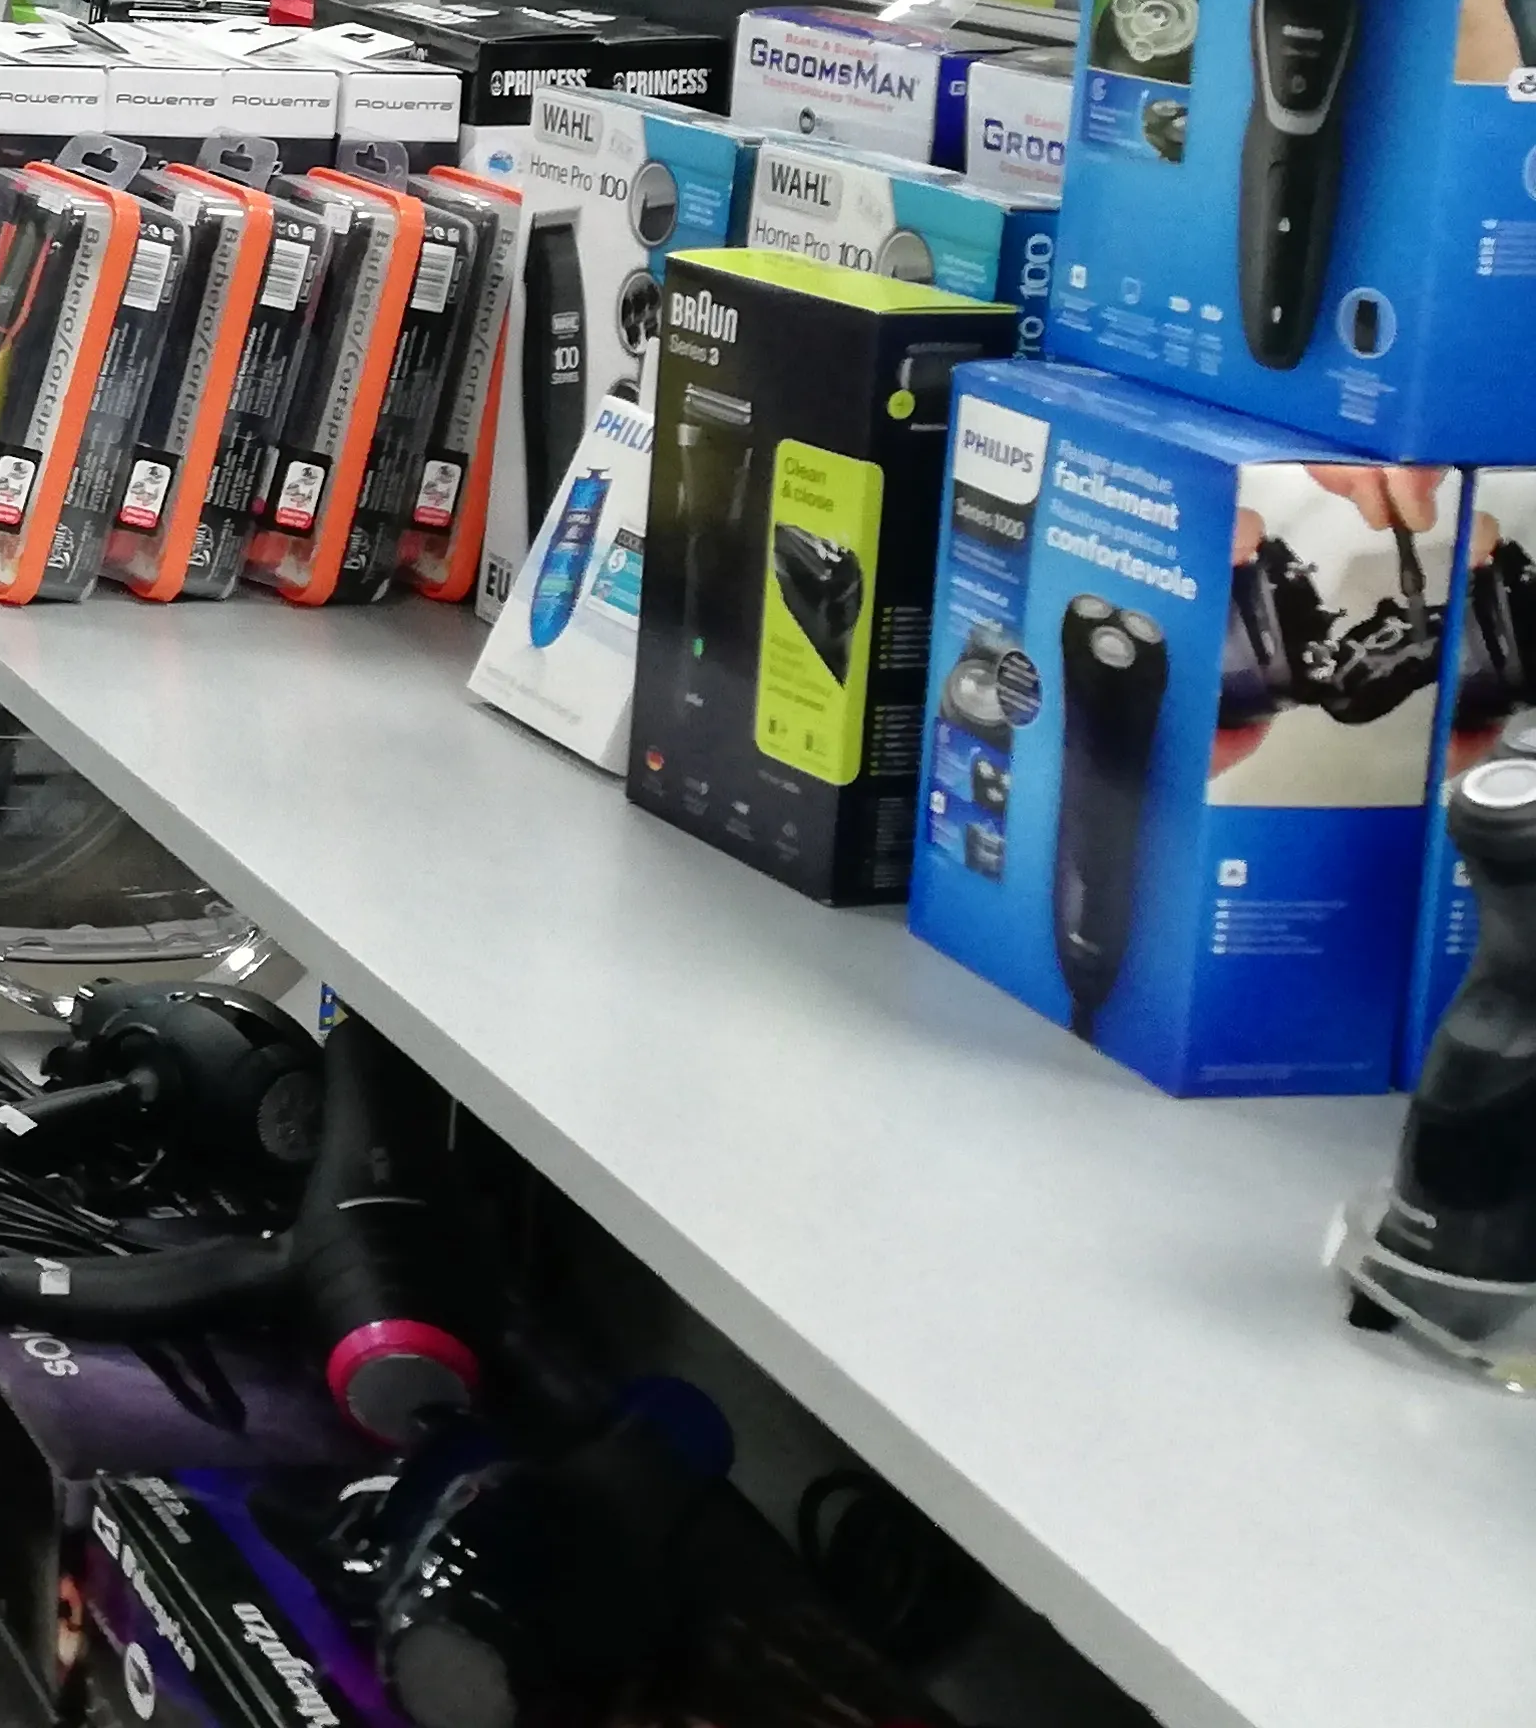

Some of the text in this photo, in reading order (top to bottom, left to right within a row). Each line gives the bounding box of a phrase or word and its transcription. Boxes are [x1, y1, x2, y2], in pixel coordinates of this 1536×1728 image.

[115, 90, 217, 108] Rowenta
[502, 68, 589, 97] PRINCESS
[625, 68, 708, 96] PRINCESS
[231, 92, 331, 110] Rowenta
[353, 96, 454, 112] Rowenta
[542, 102, 595, 144] WAHL
[981, 118, 1066, 166] GROO
[529, 154, 628, 201] Home Pro 100
[769, 161, 833, 208] WAHL
[752, 218, 873, 273] Home Pro 100
[1019, 232, 1054, 299] 100
[670, 289, 739, 344] BRAUN
[554, 345, 580, 370] 100
[668, 333, 707, 363] Series
[962, 428, 1034, 474] PHILIPS
[783, 456, 827, 486] Clean
[792, 487, 835, 513] close
[1052, 460, 1179, 532] facilement
